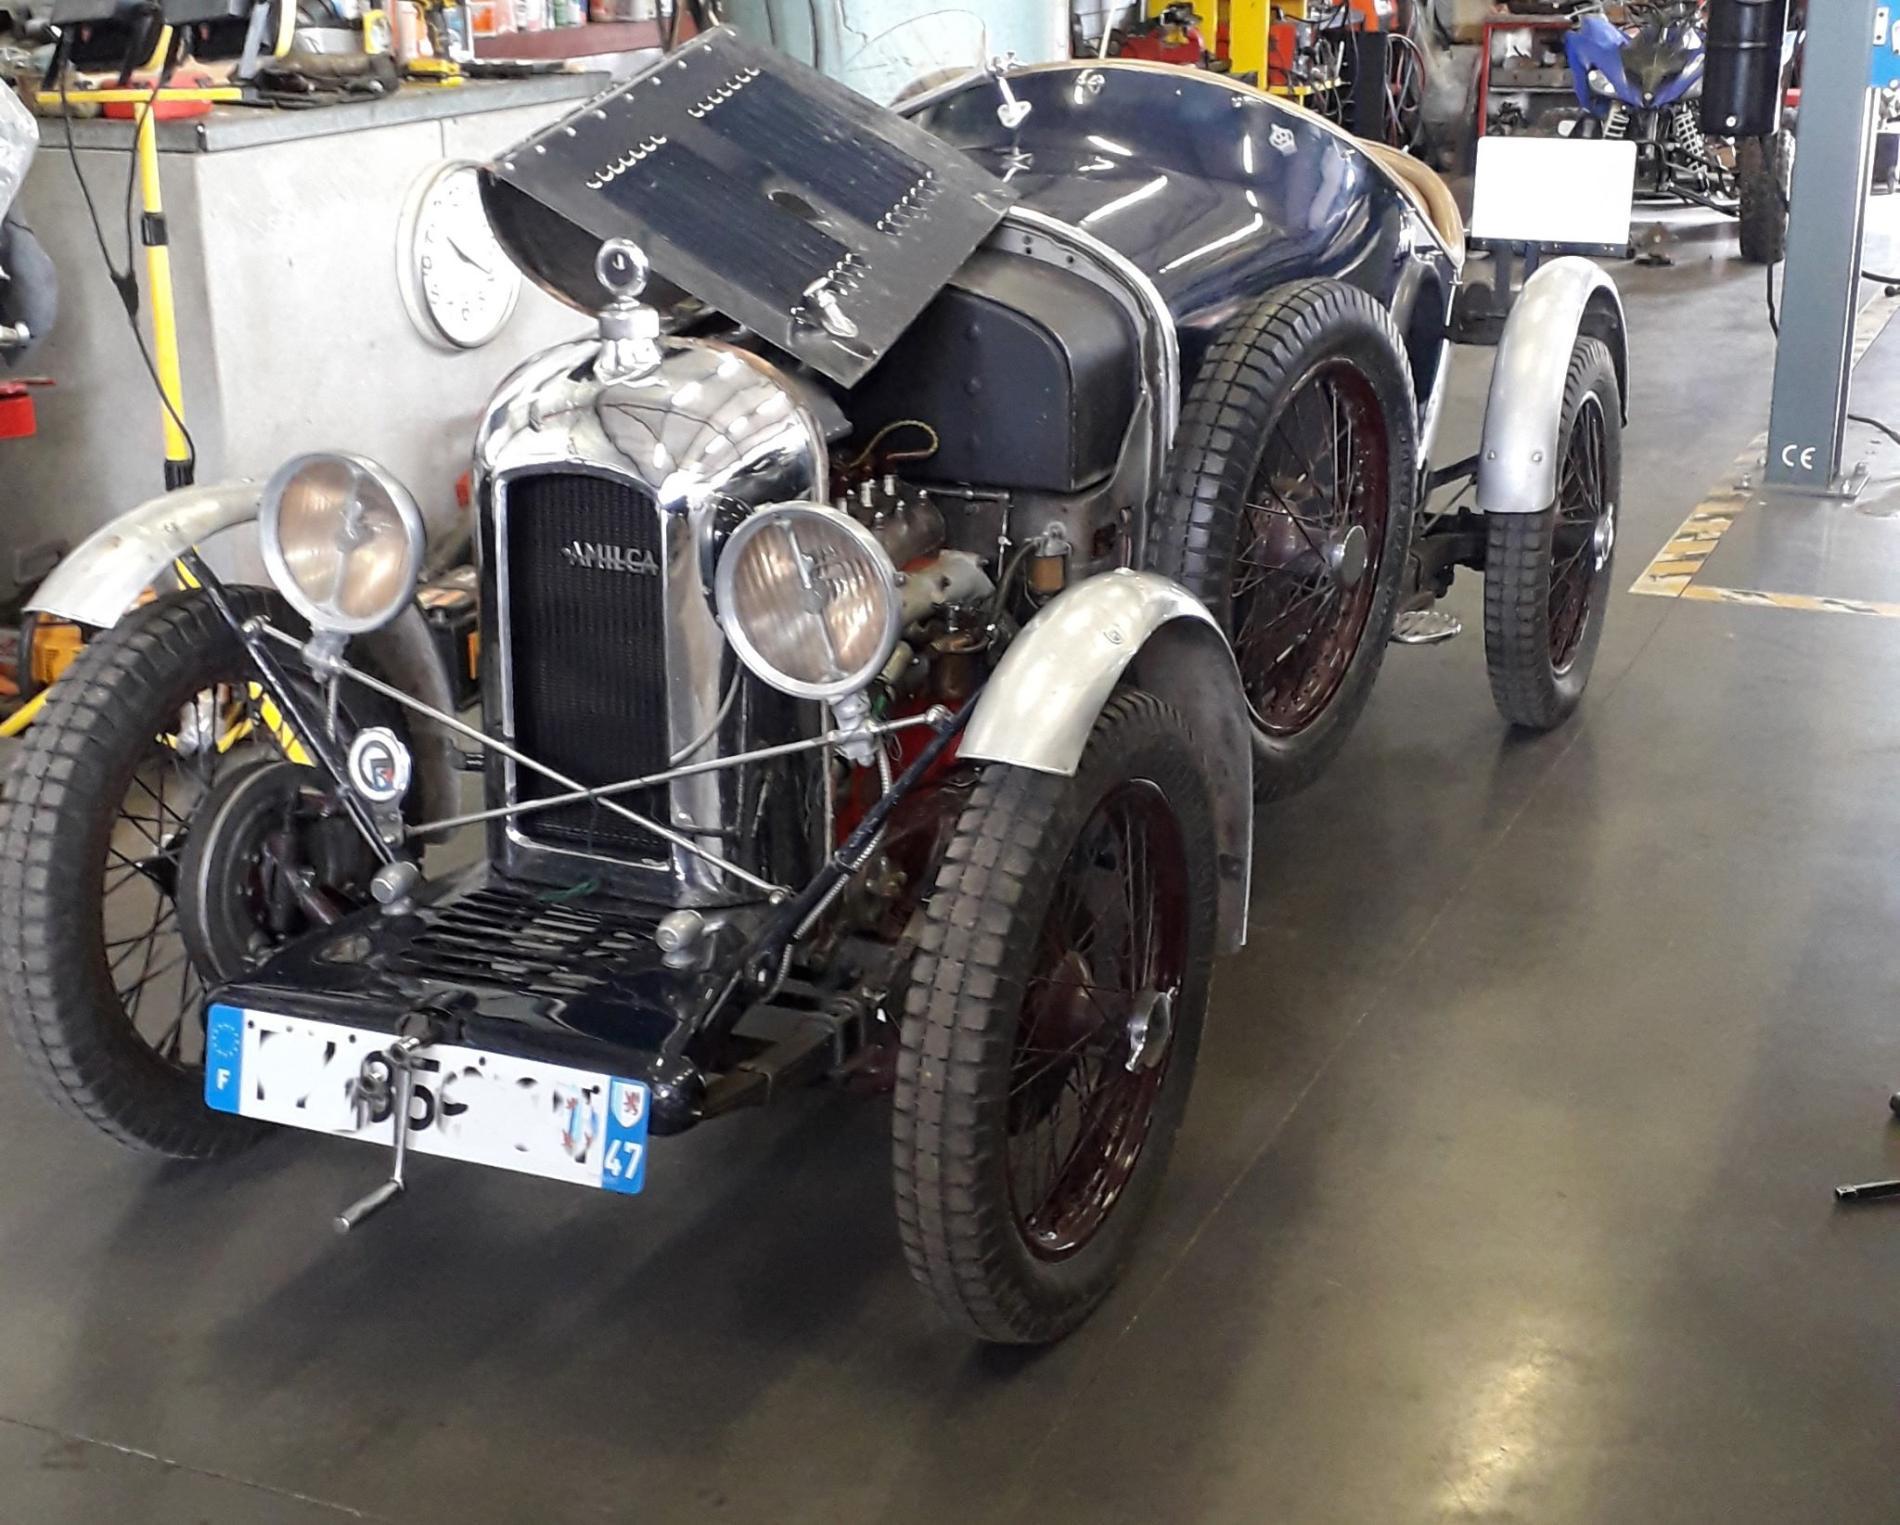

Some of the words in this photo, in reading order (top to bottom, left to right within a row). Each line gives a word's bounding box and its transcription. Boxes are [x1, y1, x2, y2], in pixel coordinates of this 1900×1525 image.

[1782, 444, 1816, 470] CE
[217, 1068, 231, 1090] F
[604, 1139, 643, 1180] 47
